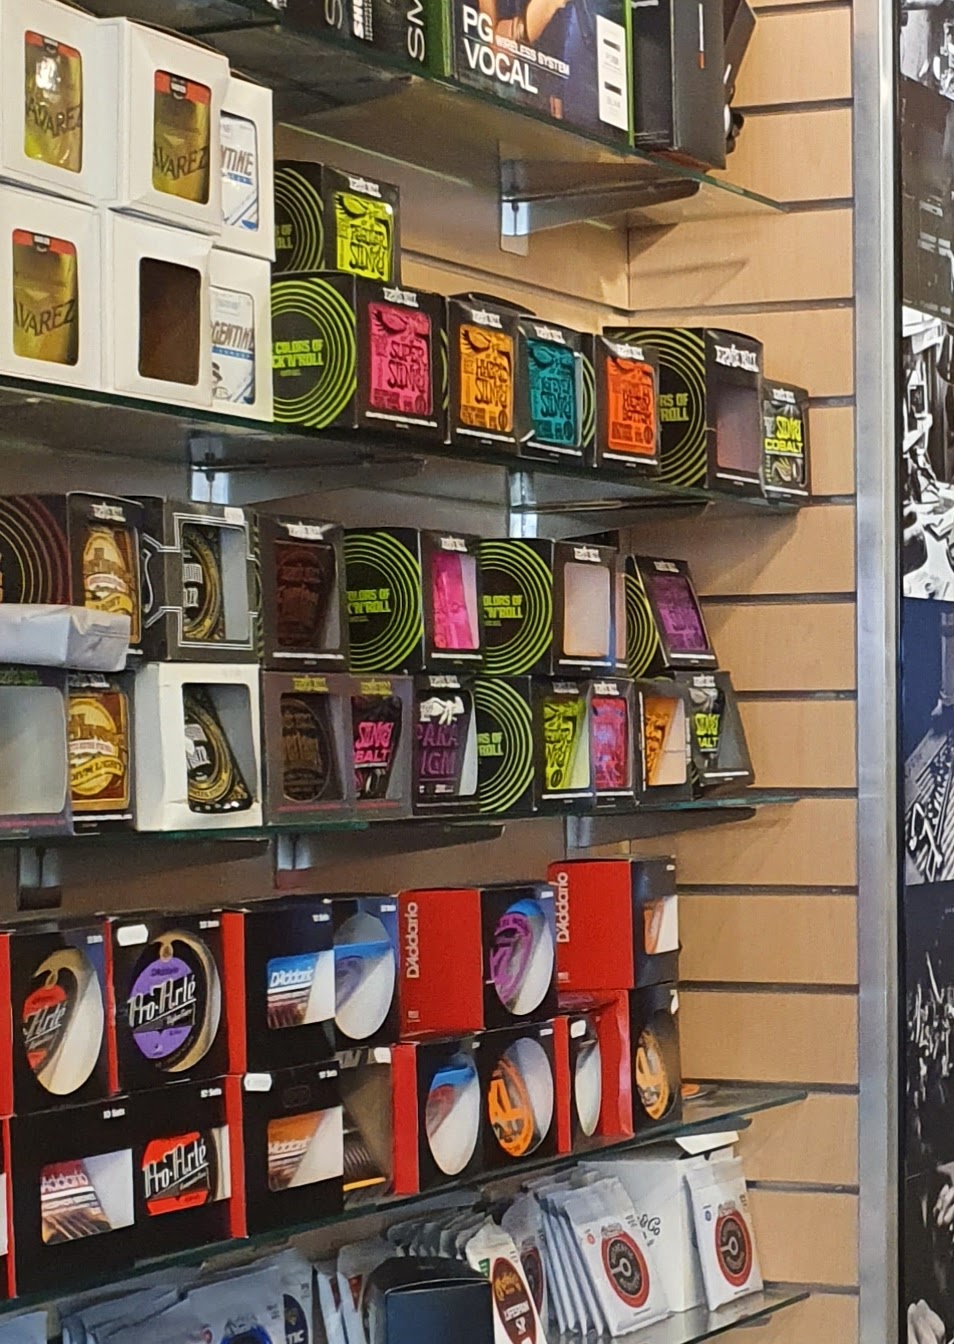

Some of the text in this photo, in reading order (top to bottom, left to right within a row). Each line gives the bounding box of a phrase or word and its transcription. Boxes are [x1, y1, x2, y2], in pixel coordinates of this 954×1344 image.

[462, 4, 494, 46] PG
[462, 37, 539, 95] VOCAL
[275, 338, 324, 355] COLORS OF
[764, 438, 803, 454] COBALT
[556, 871, 570, 943] D'Addario
[406, 902, 420, 979] D'Addario
